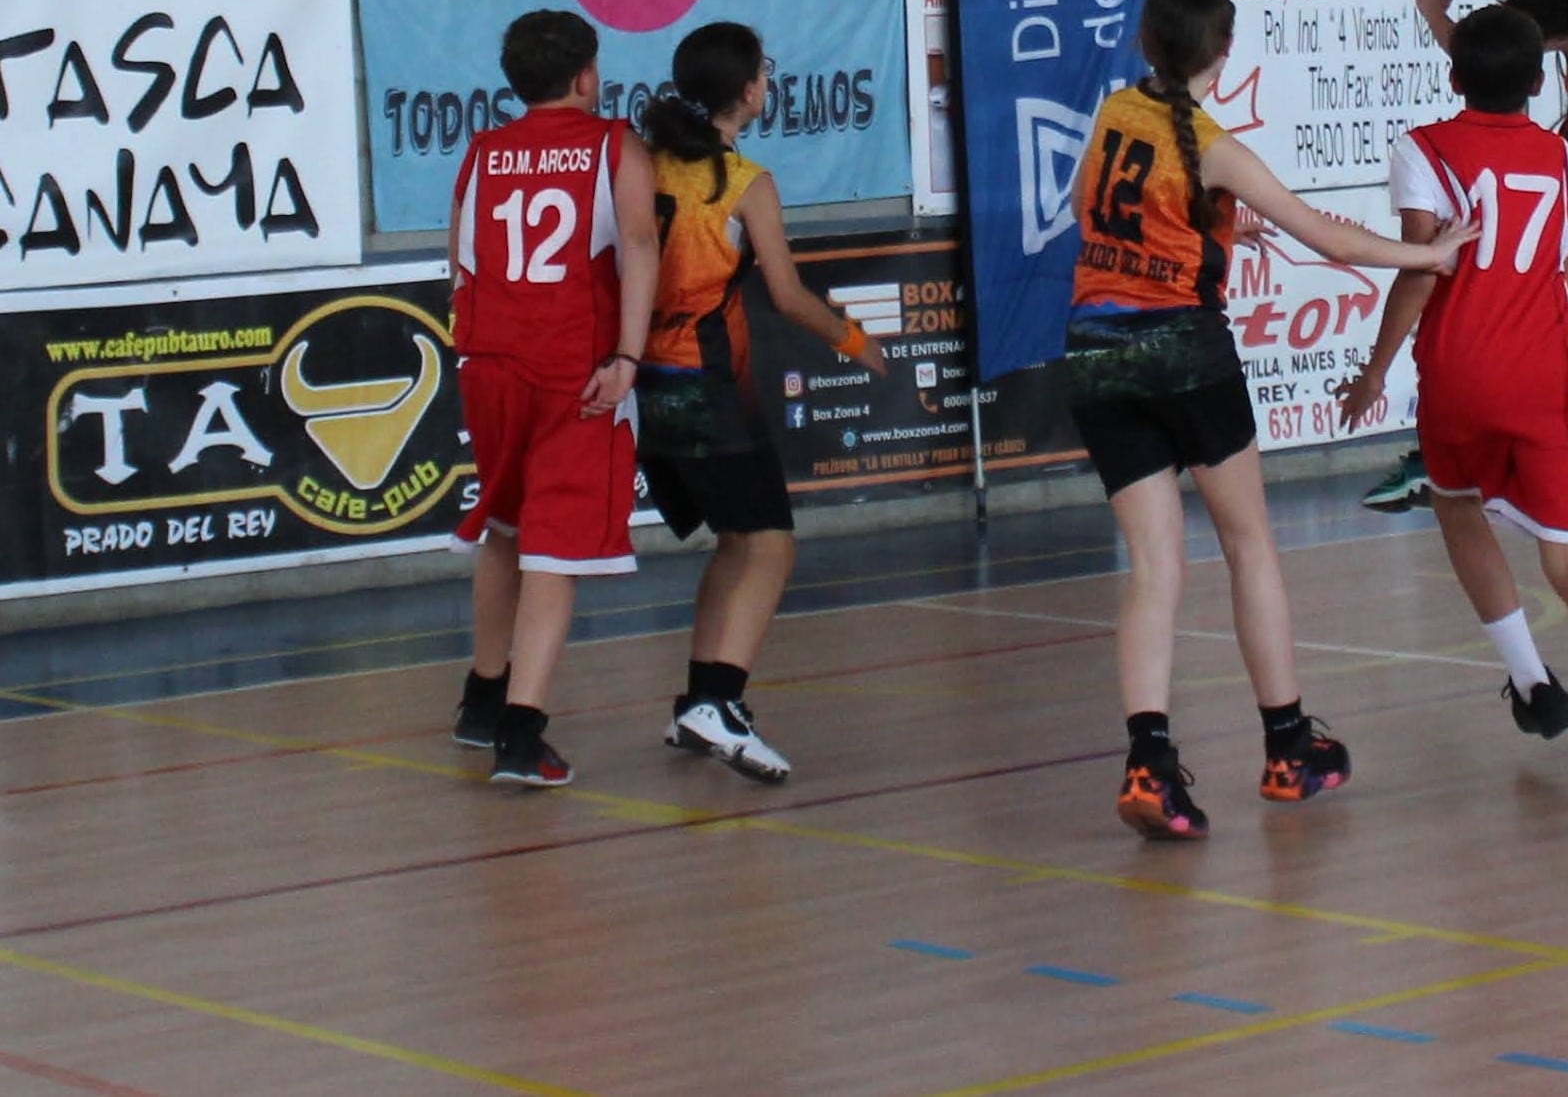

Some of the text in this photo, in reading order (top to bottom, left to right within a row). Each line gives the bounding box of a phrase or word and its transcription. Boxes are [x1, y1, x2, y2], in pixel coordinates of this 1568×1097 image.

[1264, 9, 1289, 54] Pol.
[1298, 9, 1322, 52] Ind.
[1355, 7, 1400, 52] Vientos
[1381, 63, 1405, 107] 956
[1408, 62, 1422, 105] 72
[1425, 61, 1441, 105] 34
[1295, 120, 1381, 168] PRADO DEL
[487, 147, 593, 177] E.D.M. ARCOS
[1090, 128, 1155, 244] 12
[492, 187, 578, 284] 12
[1468, 167, 1561, 274] 17
[902, 281, 954, 306] BOX
[47, 327, 272, 362] www.cafepubtauro.com
[911, 340, 965, 357] ENTRENA
[1291, 349, 1336, 375] NAVES
[808, 372, 871, 391] @boxzona4
[1257, 382, 1298, 405] REY
[812, 403, 870, 422] Box Zona 4
[1268, 405, 1304, 441] 637
[862, 421, 969, 443] www.boxzona4.com
[296, 459, 441, 520] cafe-pub
[64, 509, 277, 556] PRADO DEL REY
